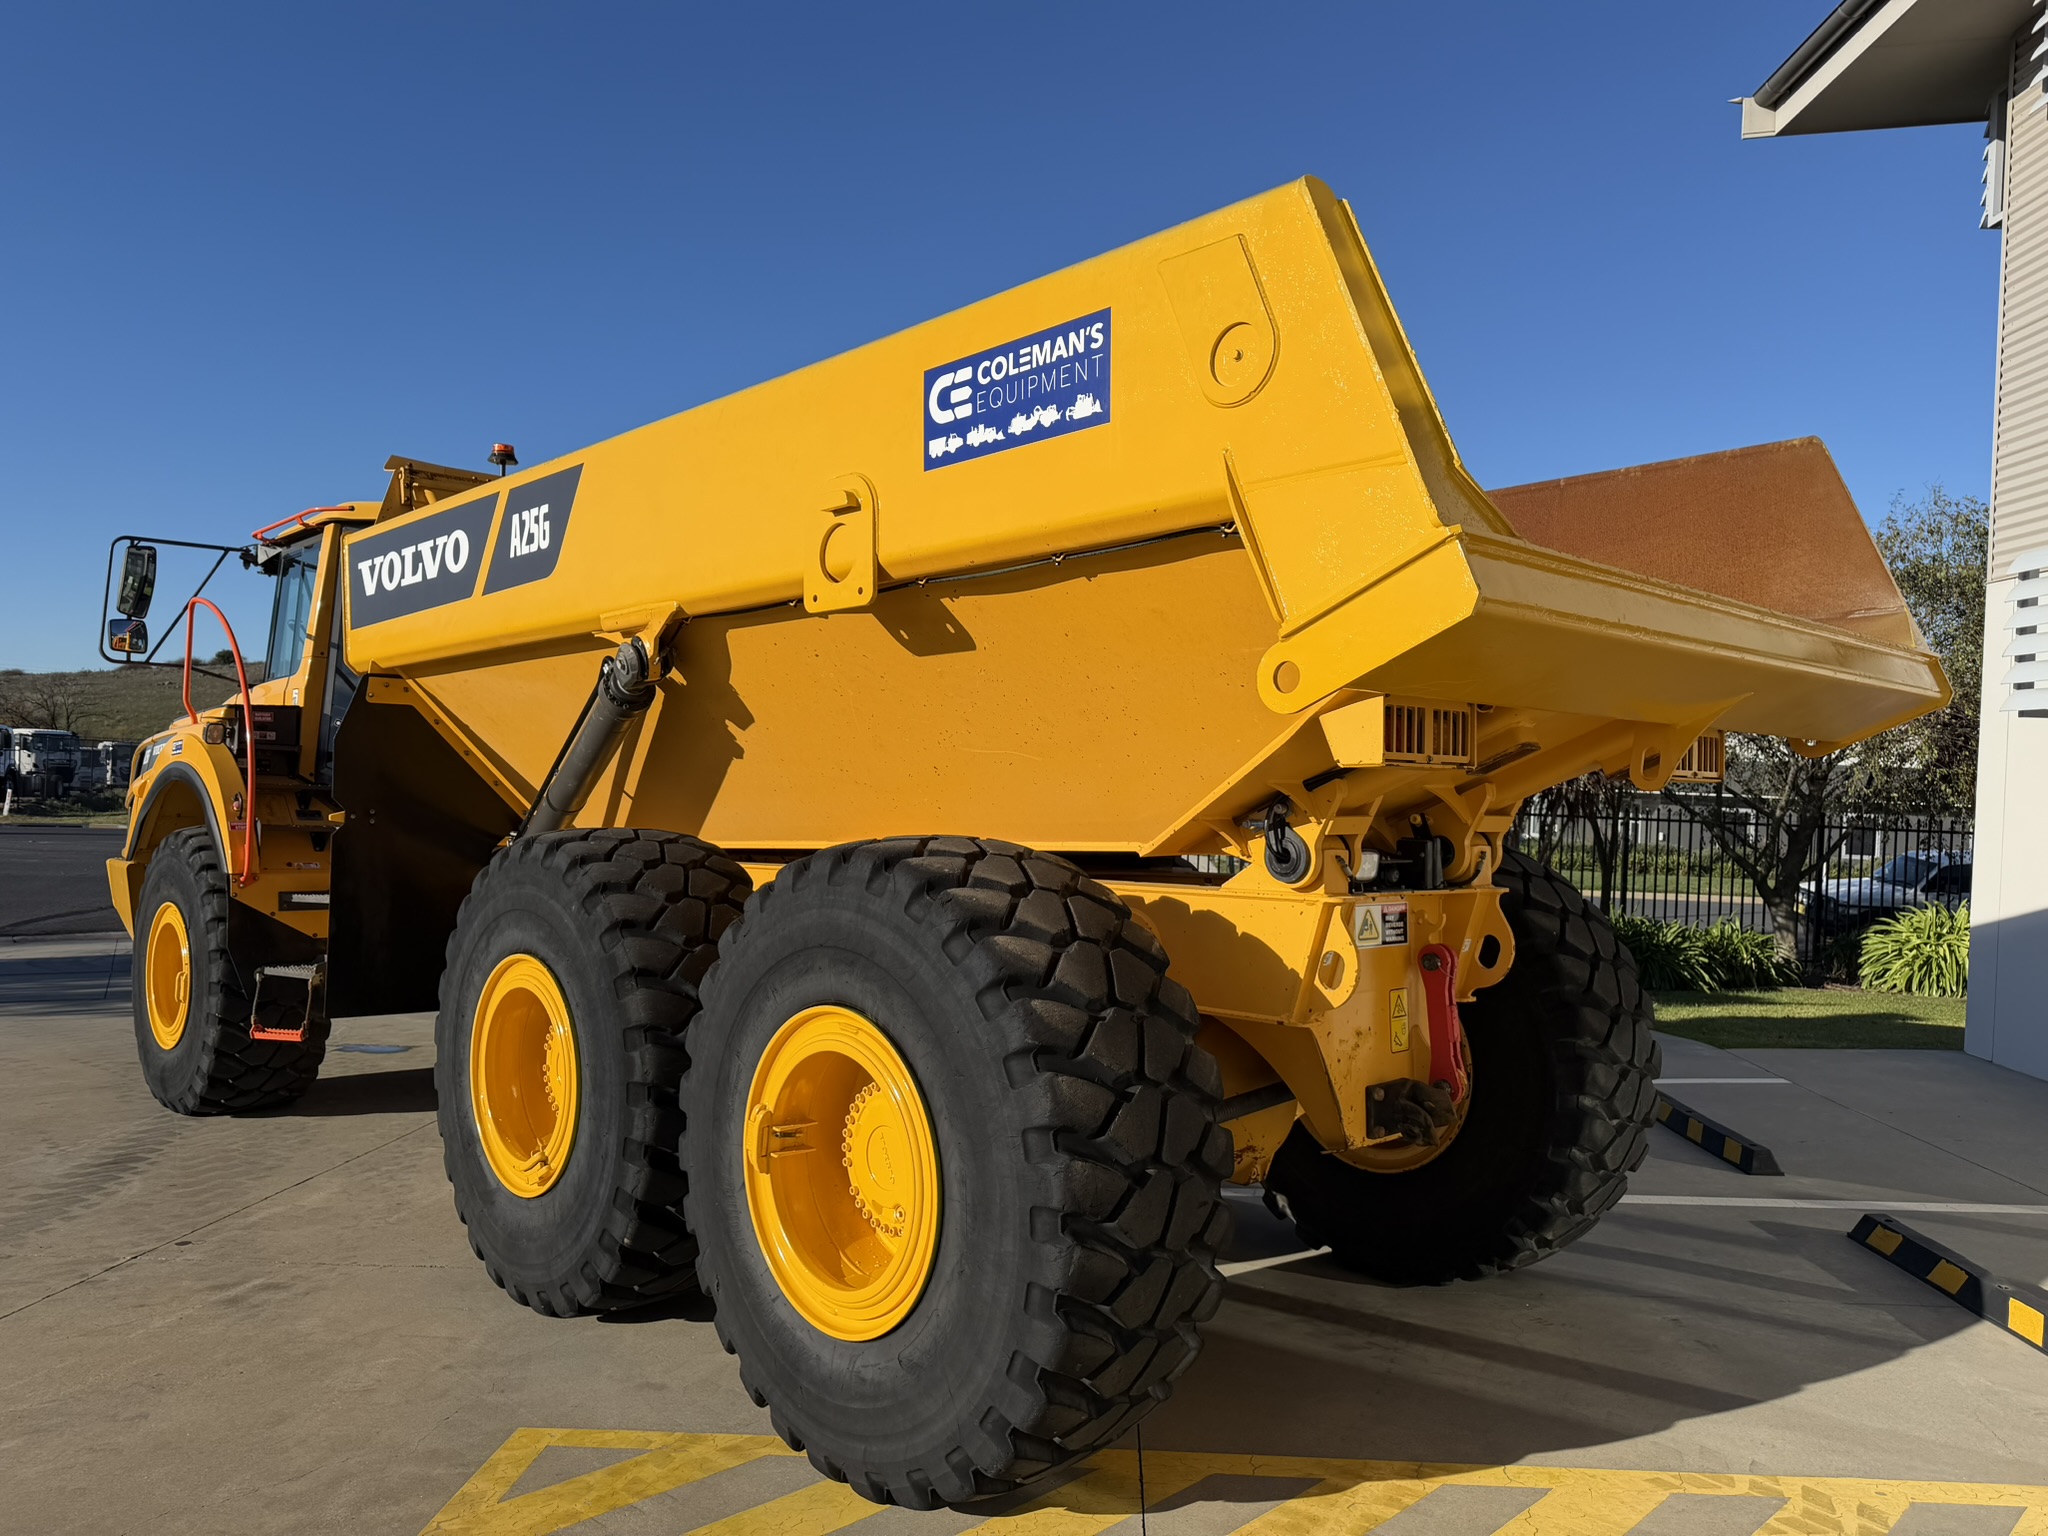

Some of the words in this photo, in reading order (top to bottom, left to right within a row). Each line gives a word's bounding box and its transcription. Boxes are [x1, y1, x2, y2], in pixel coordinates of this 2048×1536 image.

[976, 354, 1103, 414] EQUIPMENT
[977, 322, 1104, 385] COLEMAN'S
[510, 504, 550, 559] A25G
[357, 529, 470, 597] VOLVO
